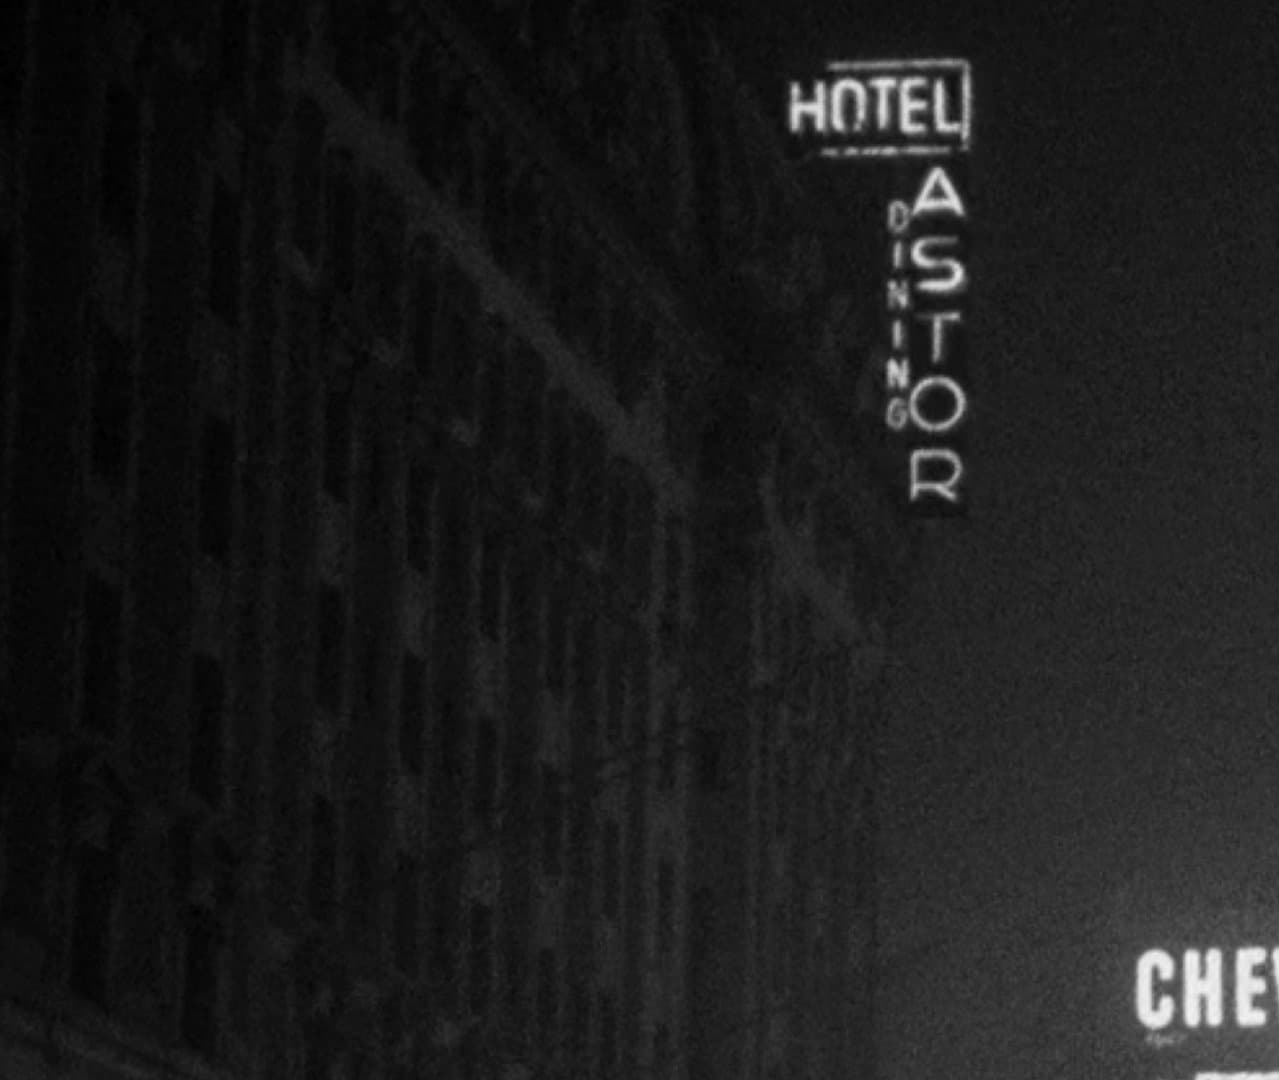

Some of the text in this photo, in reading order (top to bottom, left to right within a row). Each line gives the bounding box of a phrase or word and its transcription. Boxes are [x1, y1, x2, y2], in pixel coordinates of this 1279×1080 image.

[787, 76, 961, 134] HOTEL
[886, 200, 909, 430] DINING
[908, 166, 967, 501] ASTOR
